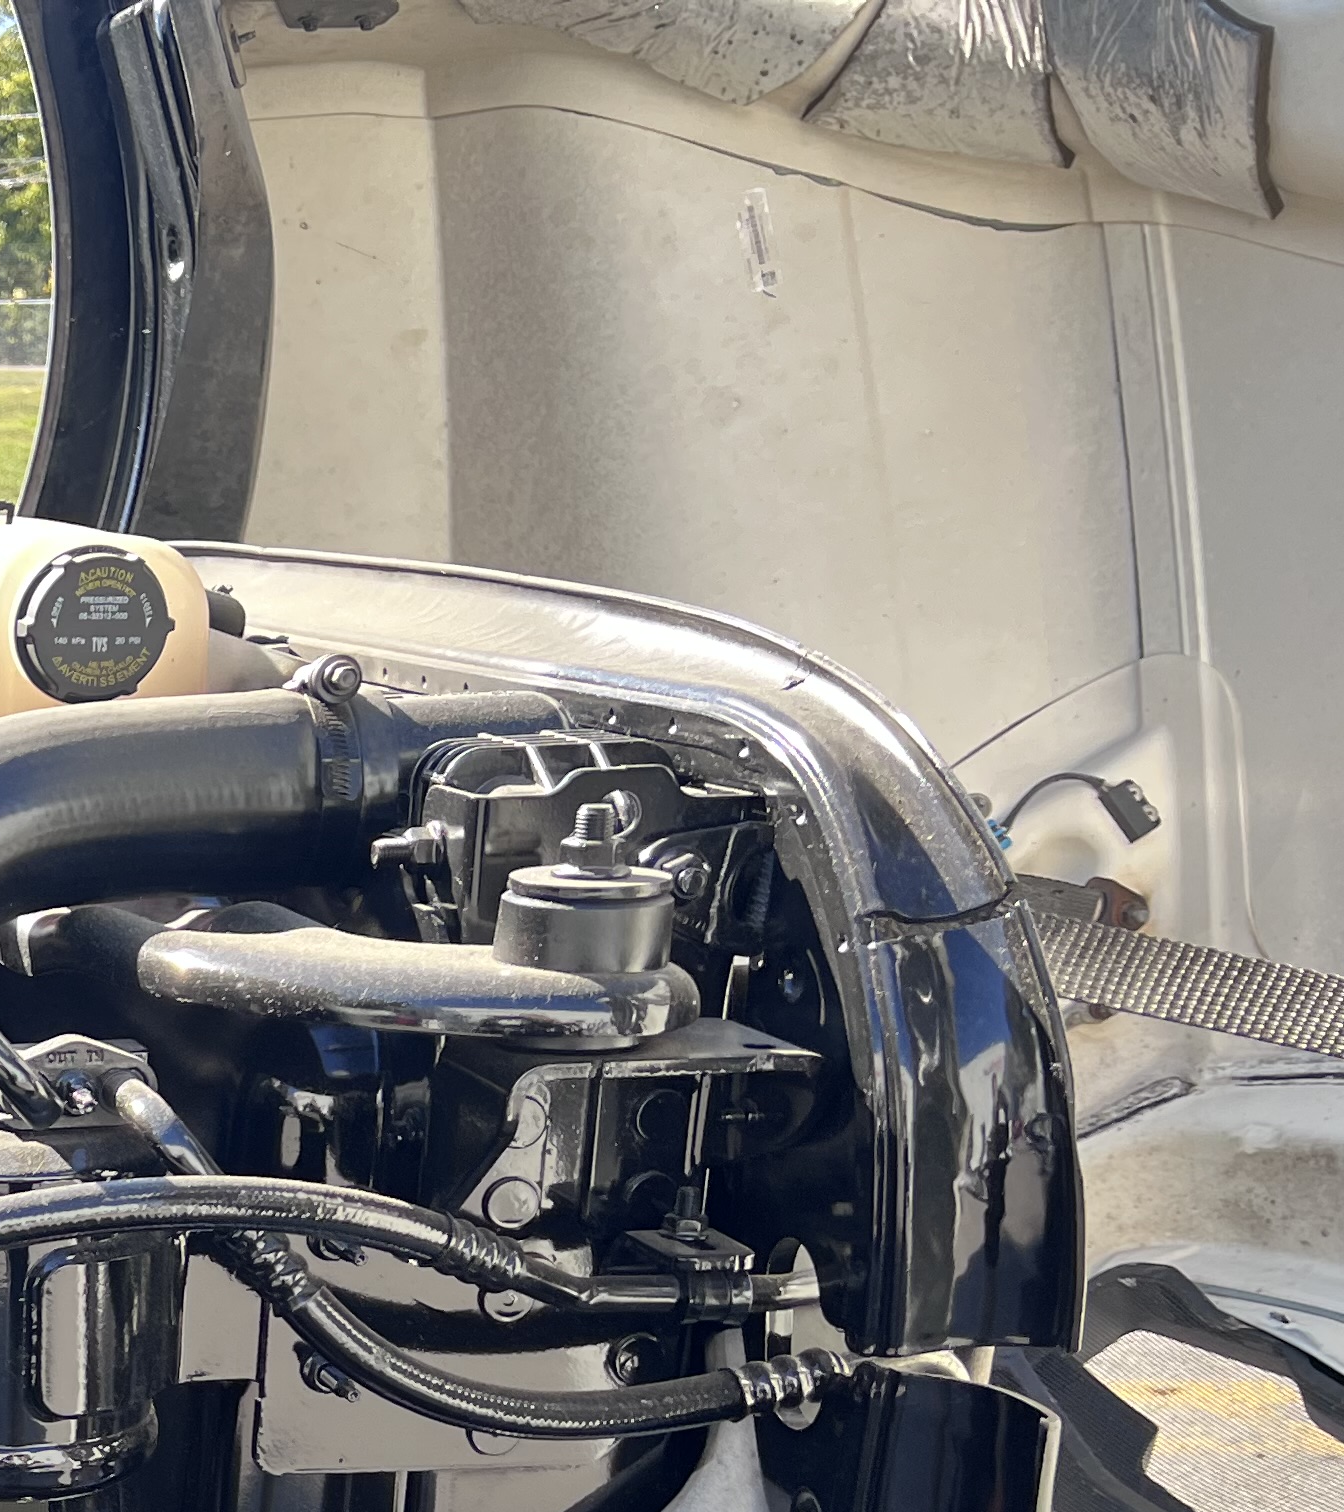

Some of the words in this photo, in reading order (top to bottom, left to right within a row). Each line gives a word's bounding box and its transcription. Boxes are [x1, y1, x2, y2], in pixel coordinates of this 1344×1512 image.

[89, 566, 134, 583] CAUTION
[80, 595, 129, 604] PRESSURIZED
[89, 604, 119, 612] SYSTEM
[92, 635, 109, 652] TVS
[115, 636, 126, 645] 20
[128, 636, 142, 645] PSI
[46, 1050, 77, 1063] OUT
